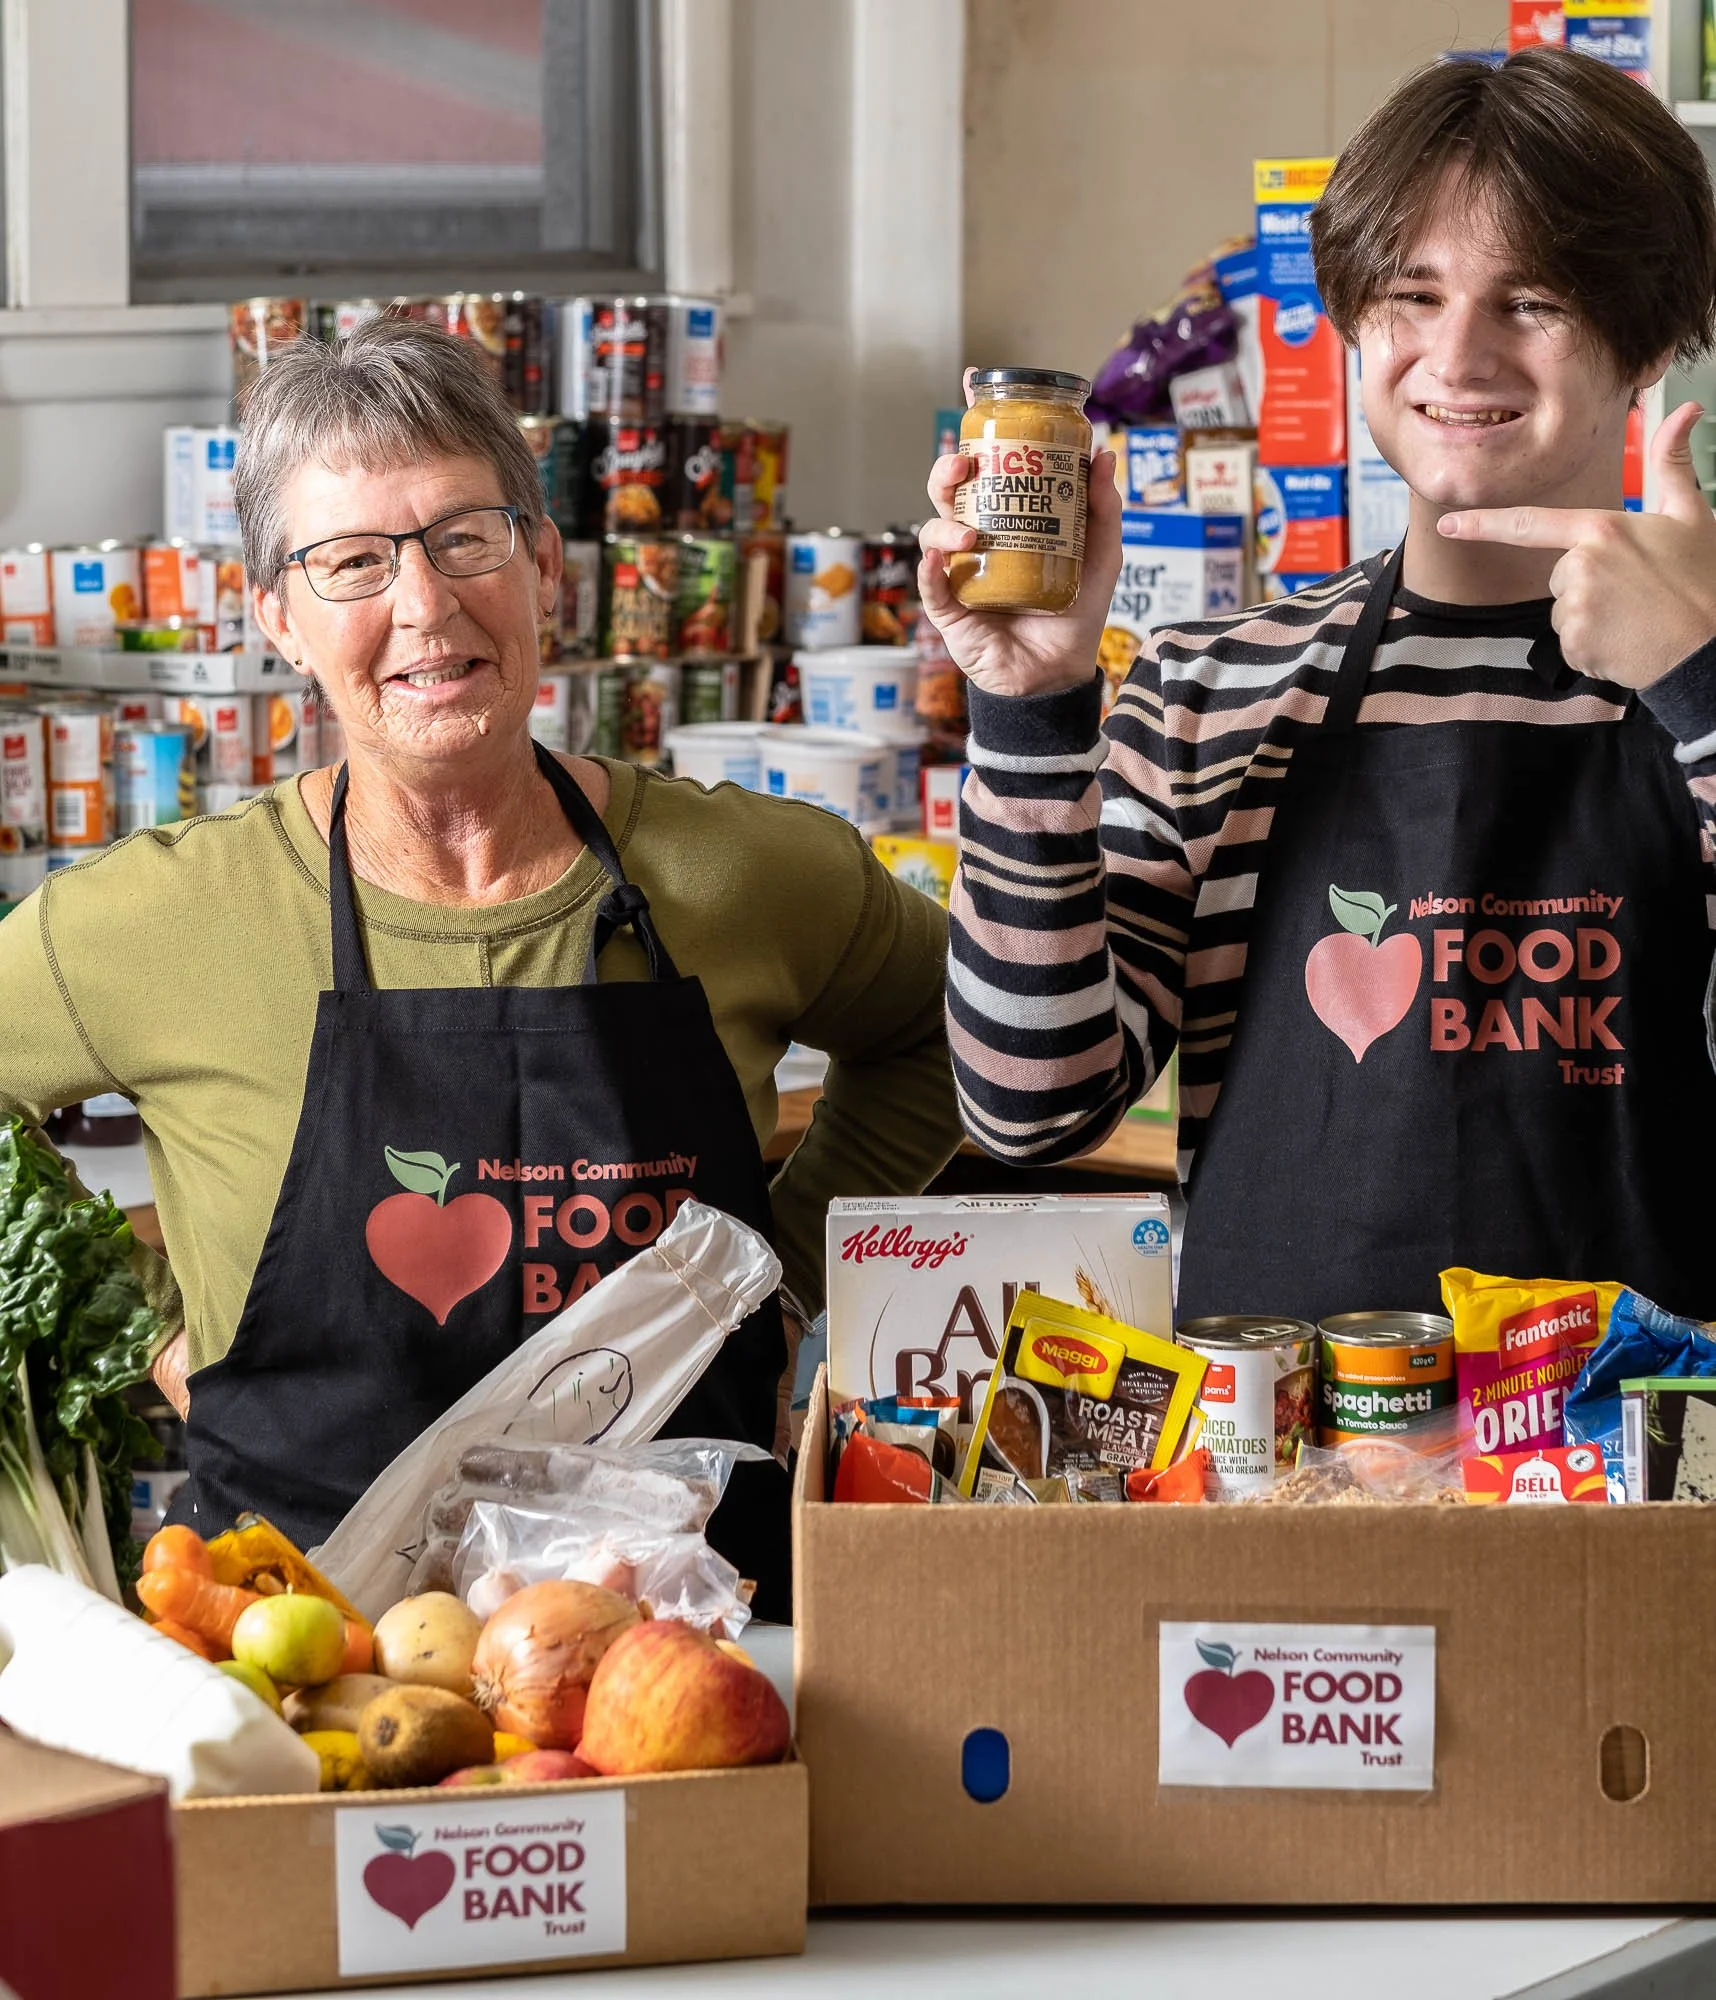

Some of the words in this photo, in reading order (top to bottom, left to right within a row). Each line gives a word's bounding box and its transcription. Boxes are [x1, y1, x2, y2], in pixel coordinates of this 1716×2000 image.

[1046, 453, 1073, 462] REALLY
[1053, 461, 1074, 472] GOOD
[982, 475, 1057, 494] PEANUT
[975, 494, 1053, 514] BUTTER
[991, 517, 1047, 531] CRUNCHY
[1122, 563, 1167, 587] ter
[1111, 591, 1151, 621] isp
[1408, 891, 1475, 920] Nelson
[1480, 889, 1624, 919] Community
[1433, 927, 1621, 984] FOOD
[1430, 996, 1625, 1051] BANK
[1557, 1060, 1625, 1085] Trust
[478, 1158, 565, 1181] Nelson
[571, 1152, 698, 1180] Community
[841, 1224, 969, 1269] Kellogg's
[1505, 1304, 1592, 1351] Fantastic
[1042, 1342, 1099, 1369] Maggi
[1122, 1380, 1142, 1388] REAL
[1143, 1381, 1169, 1389] HERBS
[1128, 1371, 1145, 1379] MADE
[1146, 1371, 1163, 1381] WITH
[1204, 1386, 1230, 1396] pams
[1323, 1383, 1433, 1418] Spaghetti
[1472, 1387, 1482, 1407] 2
[1486, 1370, 1533, 1402] MINUTE
[1078, 1397, 1158, 1432] ROAST
[1336, 1416, 1344, 1425] In
[1343, 1417, 1379, 1430] Tomato
[1379, 1420, 1409, 1430] Sauce
[1475, 1386, 1572, 1453] ORIE
[1086, 1420, 1154, 1452] MEAT
[1201, 1436, 1267, 1454] TOMATOES
[1102, 1443, 1148, 1458] FLAVOURED
[1106, 1452, 1140, 1466] GRAVY
[1229, 1455, 1248, 1465] WITH
[1220, 1465, 1234, 1474] AND
[1235, 1464, 1268, 1475] OREGANO
[1515, 1477, 1560, 1493] BELL
[1254, 1647, 1309, 1662] Nelson
[1313, 1649, 1403, 1666] Community
[1283, 1670, 1403, 1704] FOOD
[1282, 1713, 1403, 1746] BANK
[1360, 1751, 1403, 1767] Trust
[433, 1825, 490, 1841] Nelson
[494, 1817, 586, 1838] Community
[464, 1840, 586, 1880] FOOD
[463, 1881, 587, 1921] BANK
[543, 1920, 586, 1936] Trust
